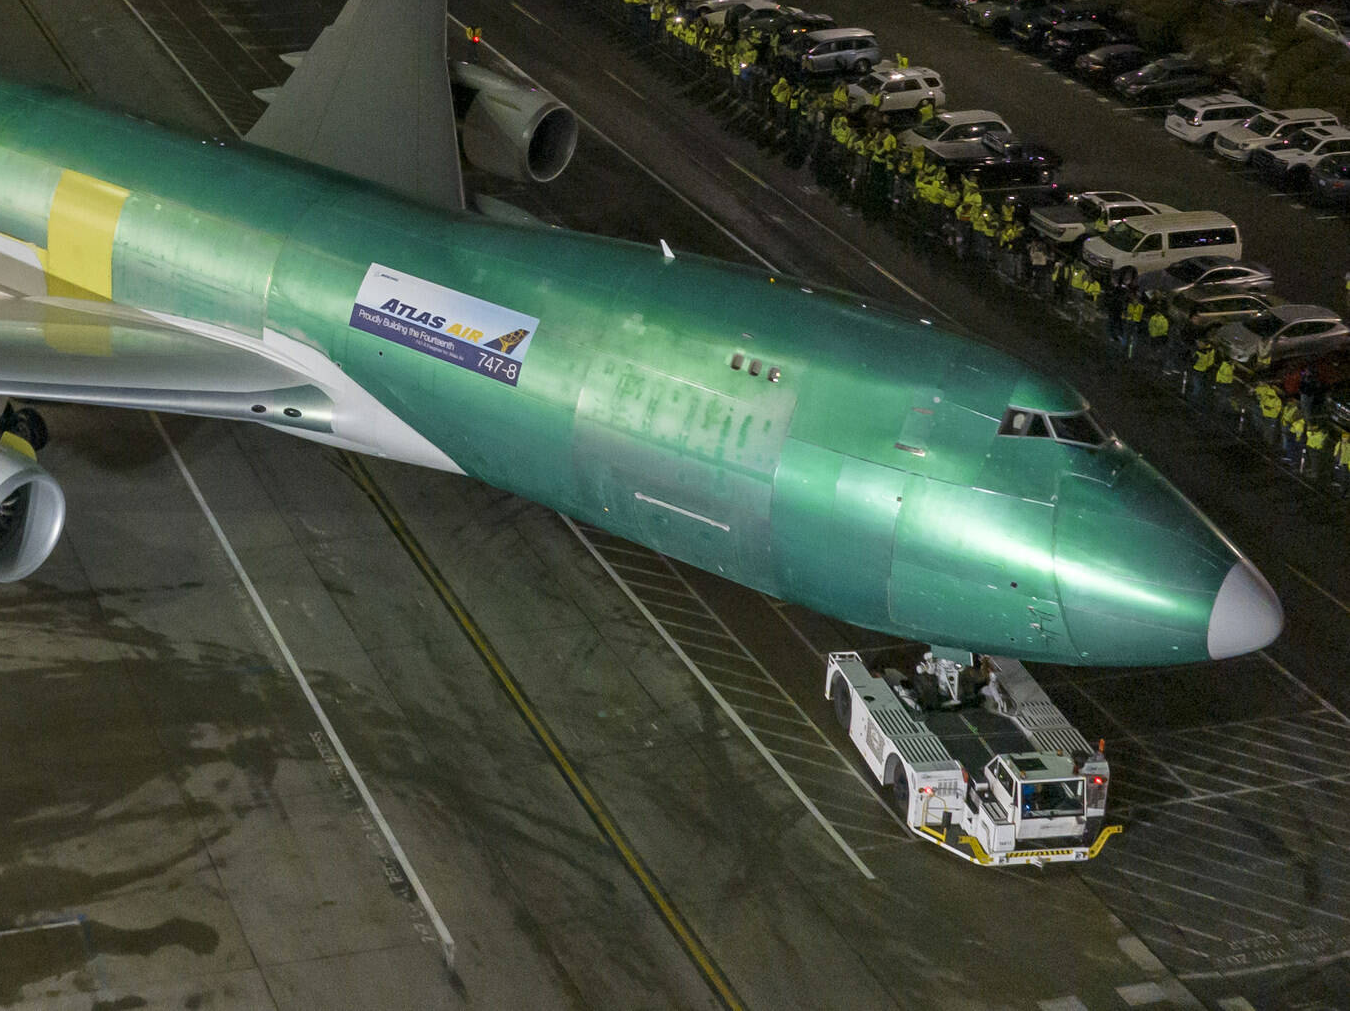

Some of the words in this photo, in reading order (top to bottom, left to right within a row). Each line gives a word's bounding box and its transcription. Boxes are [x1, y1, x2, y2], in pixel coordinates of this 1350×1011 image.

[358, 309, 383, 325] Proudly
[382, 317, 408, 335] Building
[409, 327, 420, 338] the
[419, 330, 455, 350] Fourteenth
[380, 298, 446, 329] ATLAS
[445, 322, 484, 343] AIR
[477, 352, 518, 380] 747-8
